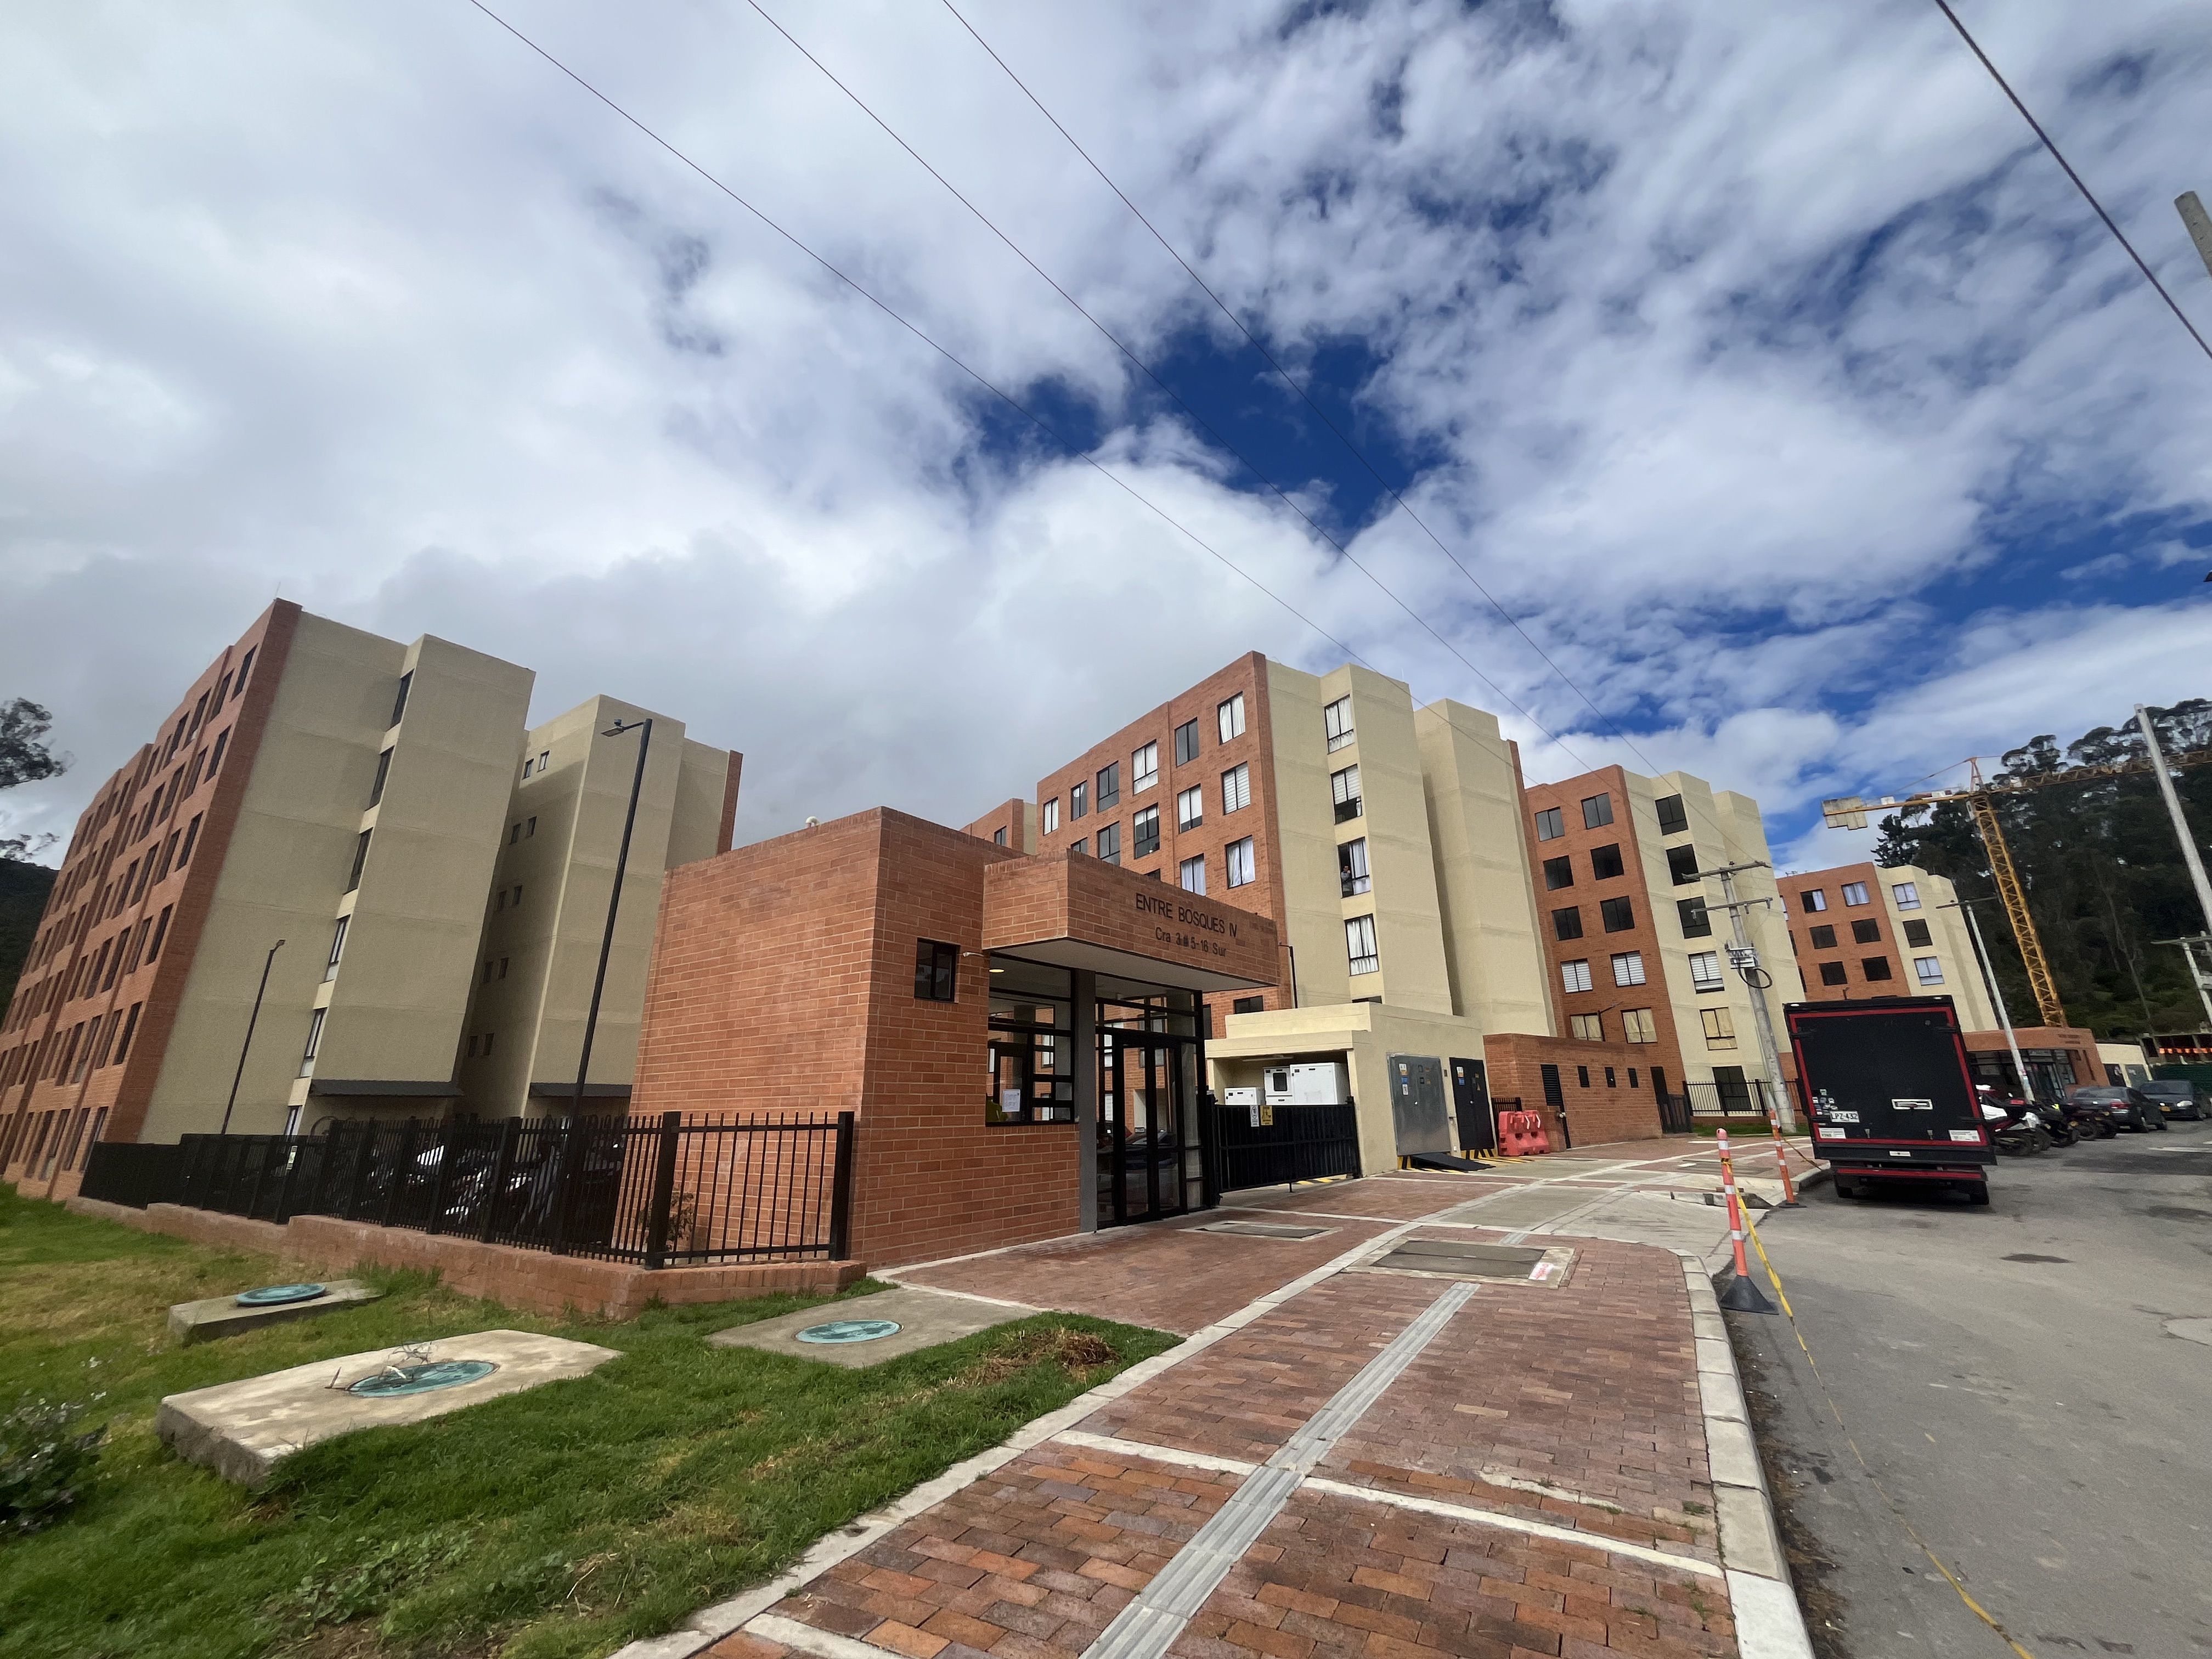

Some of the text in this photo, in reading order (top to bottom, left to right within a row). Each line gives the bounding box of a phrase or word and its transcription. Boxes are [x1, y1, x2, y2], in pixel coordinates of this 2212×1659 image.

[1136, 893, 1238, 938] ENTRE BOSQUES IV
[1155, 927, 1171, 943] Cra
[1212, 943, 1227, 957] Sur
